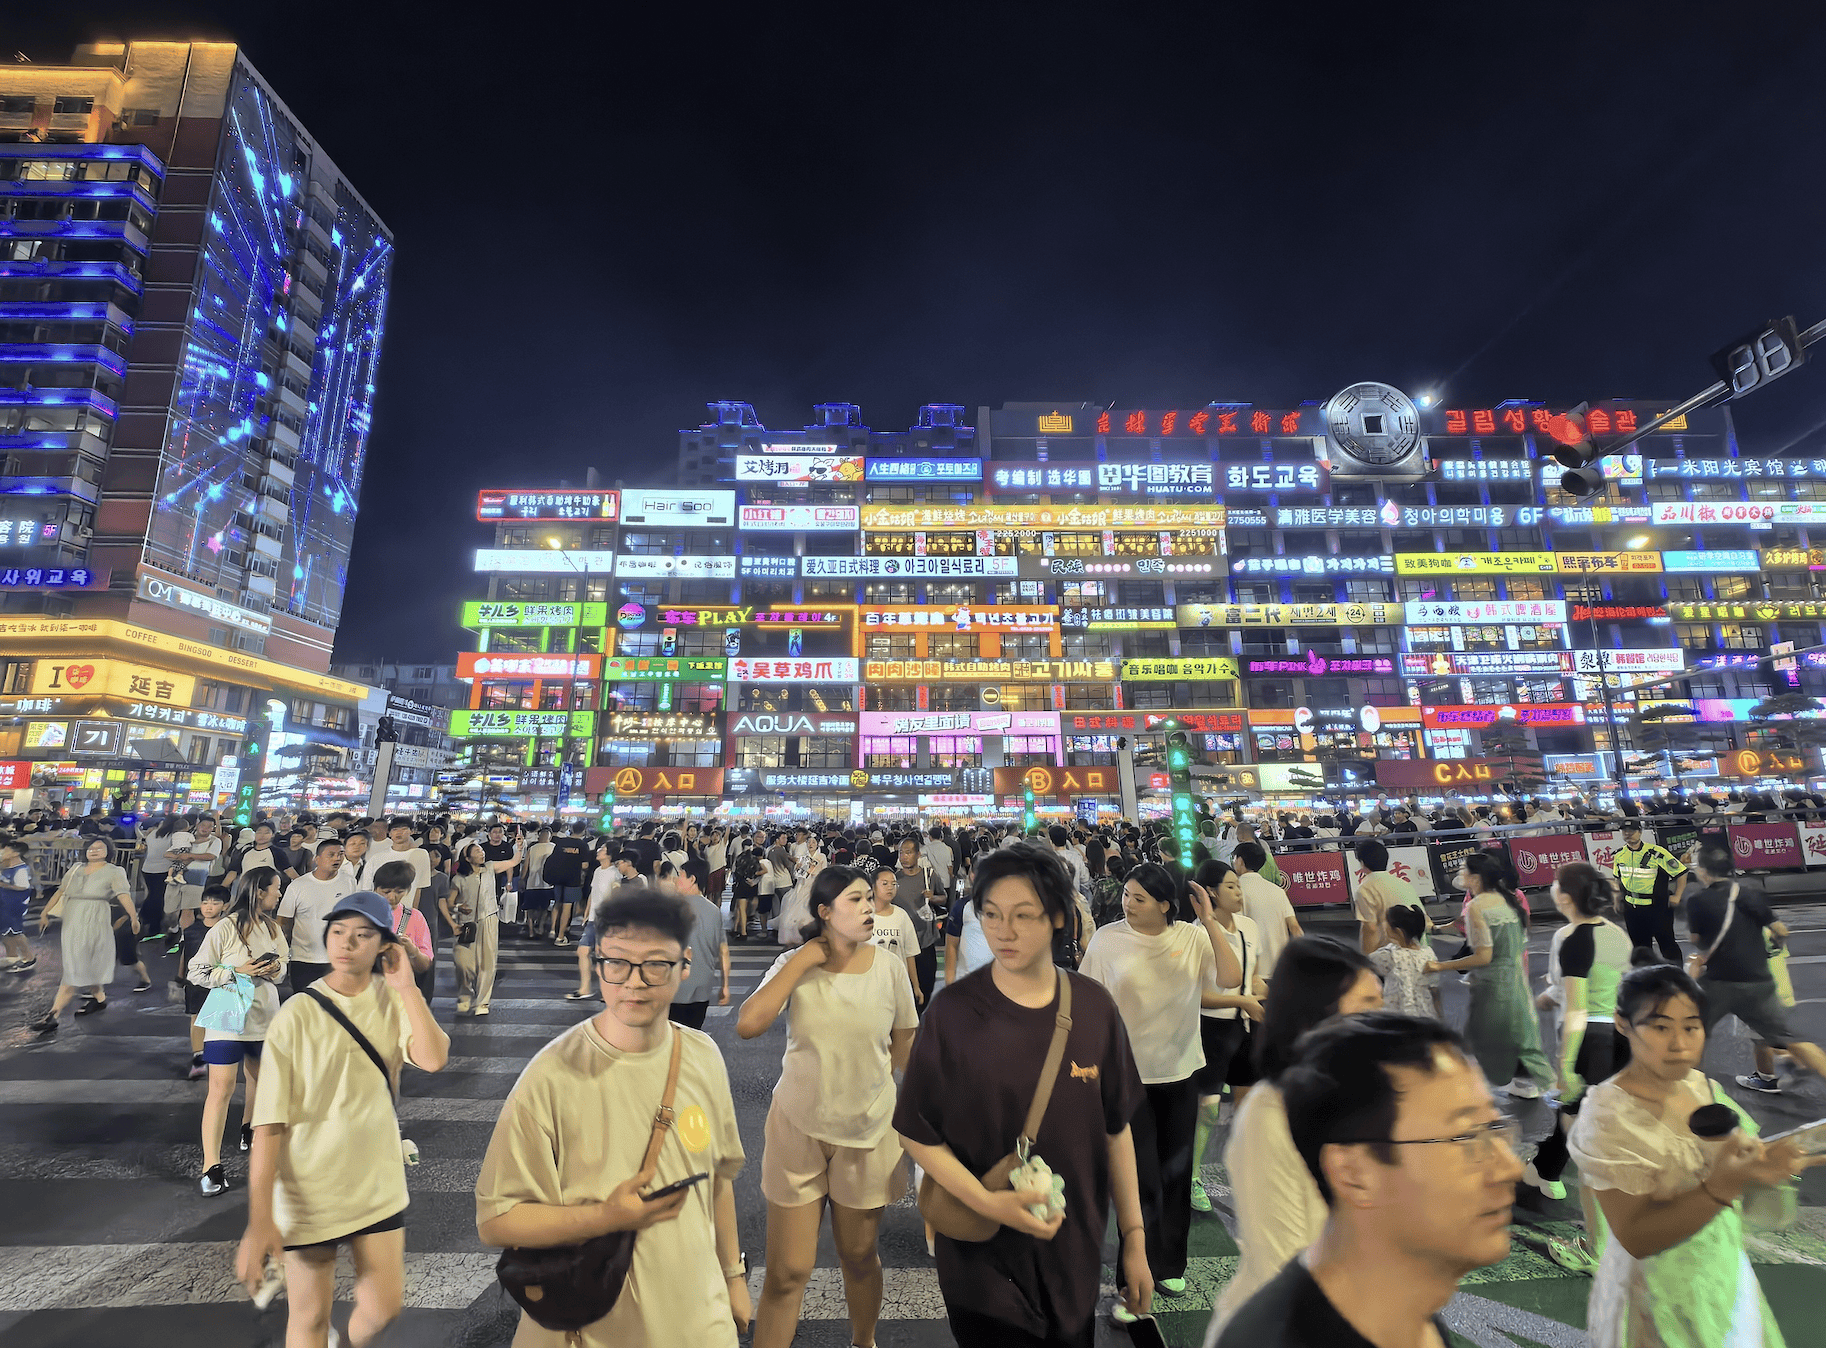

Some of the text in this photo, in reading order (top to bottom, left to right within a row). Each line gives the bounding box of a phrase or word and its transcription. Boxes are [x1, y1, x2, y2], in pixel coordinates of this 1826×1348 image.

[1446, 409, 1638, 433] 길림성황술관
[1227, 464, 1320, 489] 화도교육
[1660, 459, 1786, 477] 一米阳光宾馆
[994, 469, 1042, 487] 考编制
[1122, 464, 1213, 491] 华图教育
[644, 500, 712, 511] Hair Soo
[1112, 508, 1156, 522] 鲜果烤肉
[1404, 507, 1505, 525] 청아의학미용
[1520, 507, 1543, 524] 6F
[43, 524, 57, 536] 5F
[806, 558, 880, 575] 爱久亚日式料理
[905, 558, 985, 575] 아크아일식료리
[992, 558, 1010, 570] 5F
[524, 605, 574, 616] 鲜果烤肉
[824, 612, 837, 622] 4F
[1350, 608, 1361, 617] 24
[125, 628, 258, 669] COFFEE BINGSOO DESSERT
[49, 666, 65, 688] I
[752, 661, 833, 679] 吴草鸡爪
[1128, 662, 1231, 676] 音乐唱咖 음악가수
[129, 675, 175, 700] 延吉
[129, 702, 187, 723] 기억커피
[733, 715, 815, 732] AQUA
[84, 729, 109, 746] 기
[620, 769, 695, 790] A 入口
[765, 774, 850, 786] 服务大楼延吉冷面
[1031, 771, 1103, 789] B 入口
[1435, 763, 1451, 783] C
[1292, 869, 1342, 884] 唯世炸鸡
